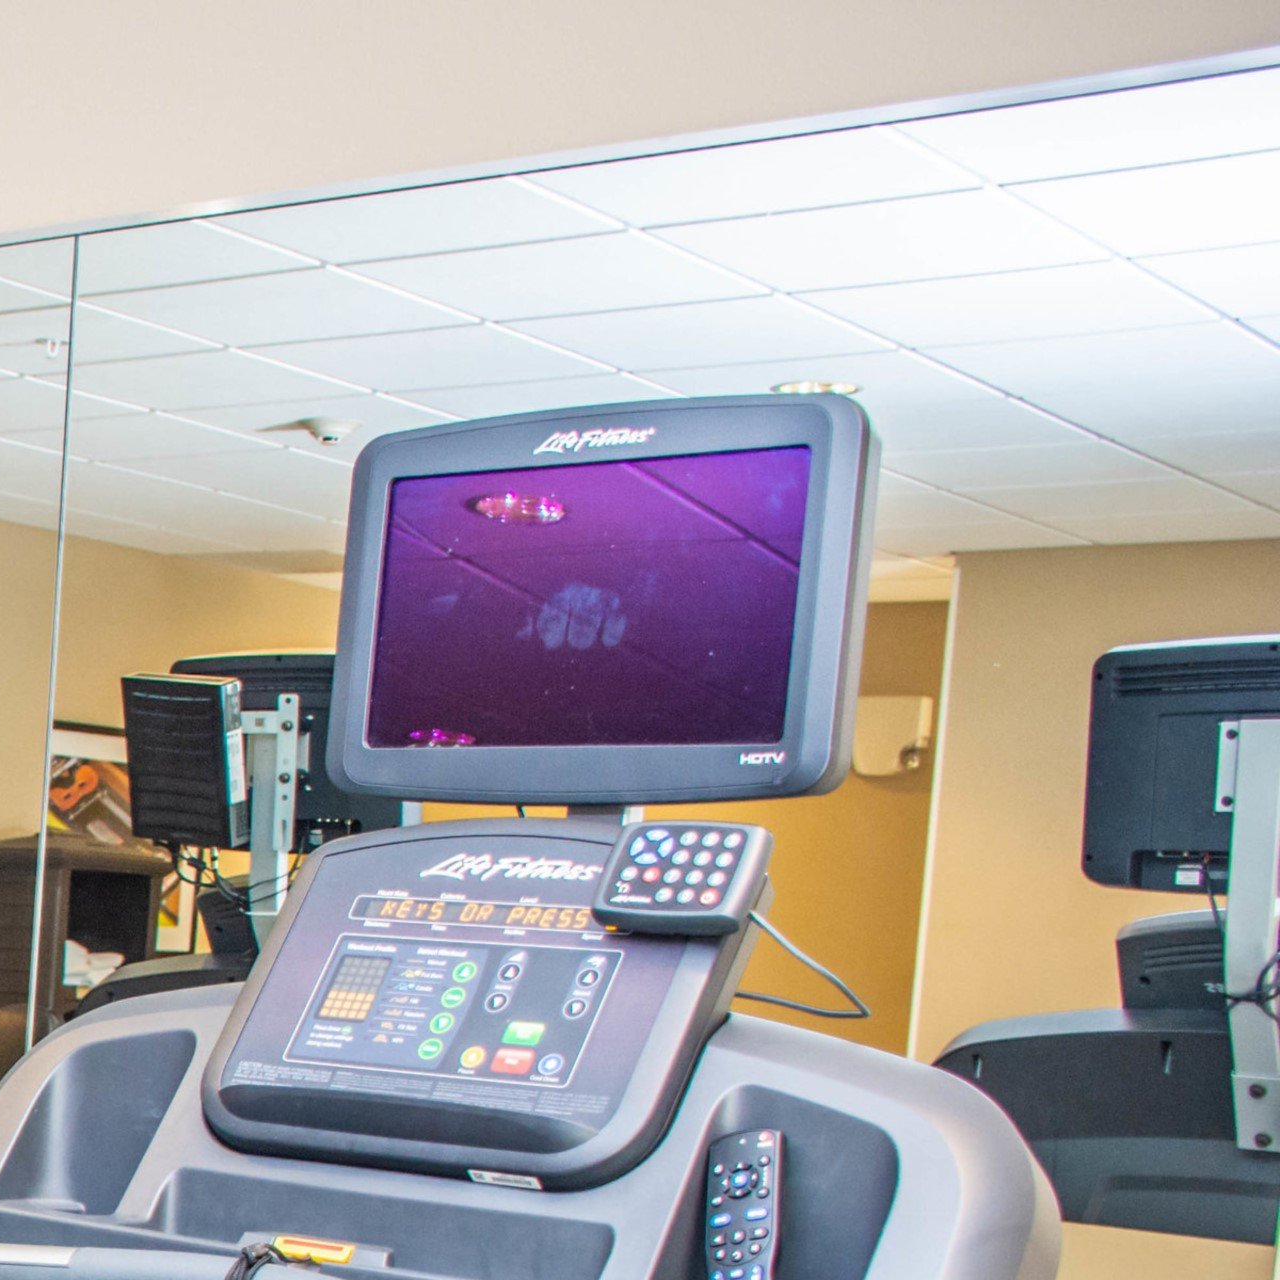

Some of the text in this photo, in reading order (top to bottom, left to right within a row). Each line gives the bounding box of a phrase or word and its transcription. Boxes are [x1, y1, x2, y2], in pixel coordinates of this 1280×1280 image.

[739, 752, 785, 765] HDTV
[380, 900, 590, 929] KEYS OR PRESS
